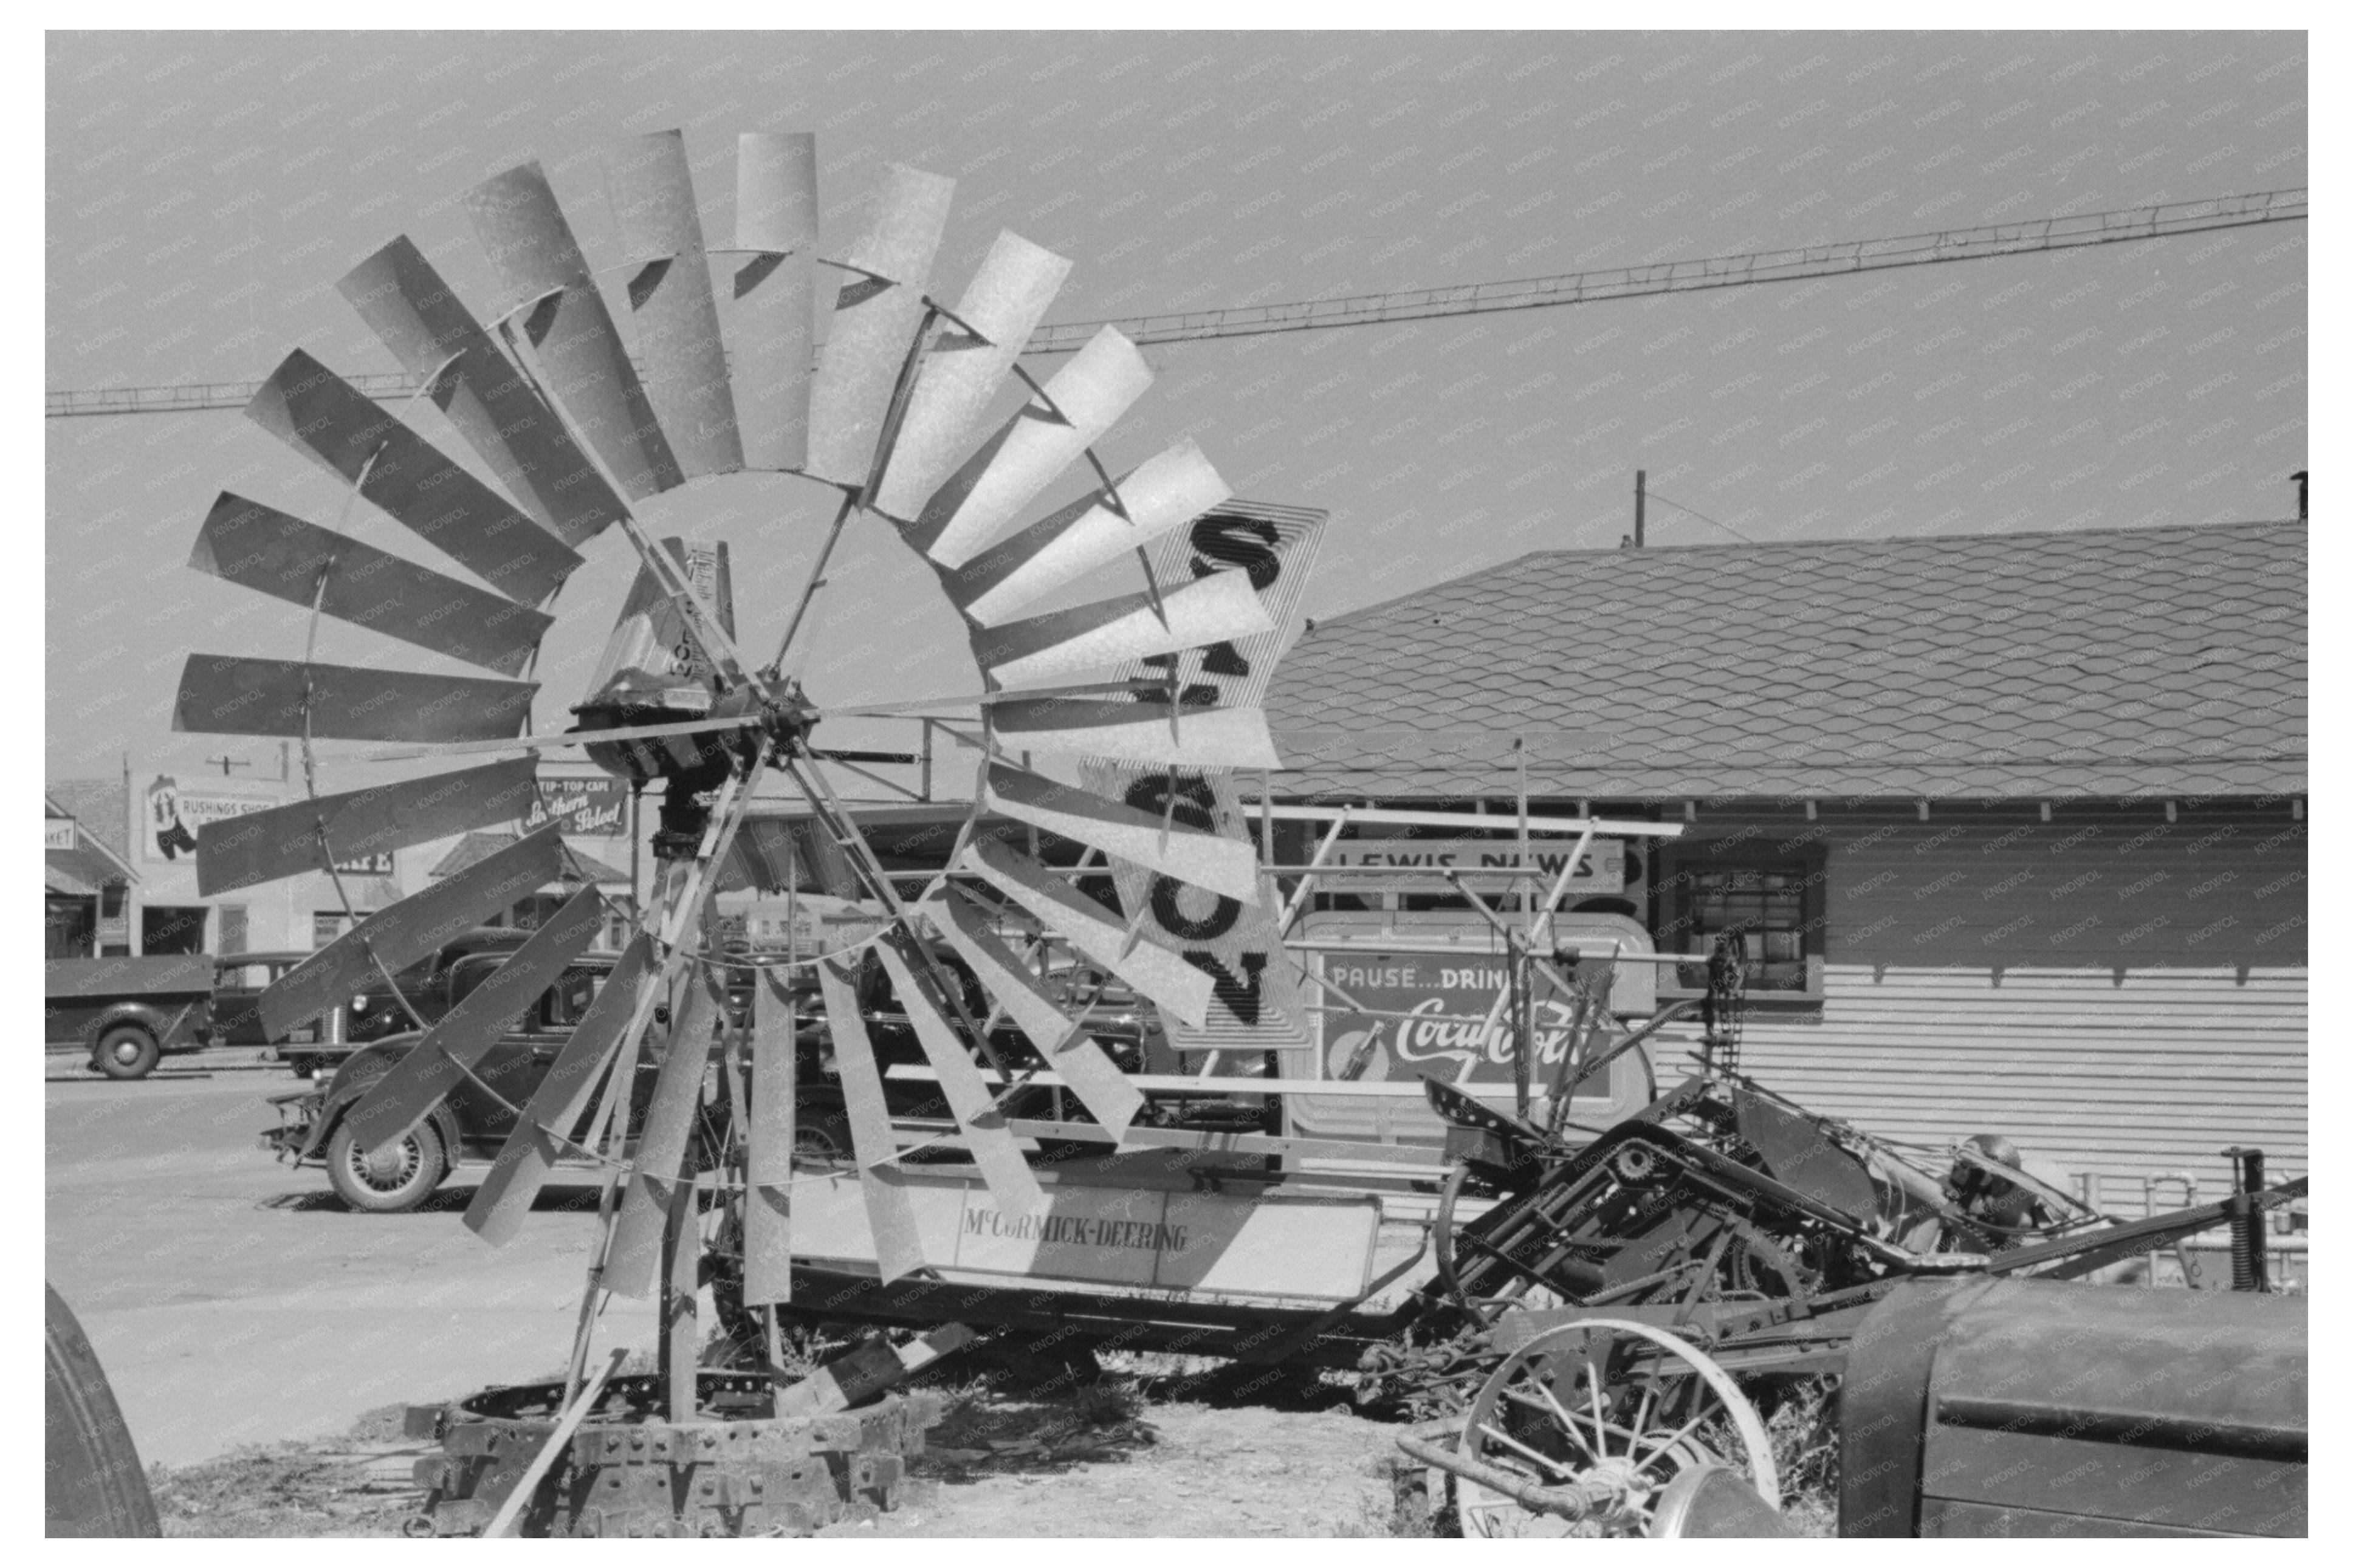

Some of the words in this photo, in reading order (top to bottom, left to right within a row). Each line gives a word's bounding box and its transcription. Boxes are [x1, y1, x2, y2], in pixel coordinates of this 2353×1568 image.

[1126, 515, 1280, 1027] SSON
[184, 801, 236, 815] RUSHINGS
[526, 795, 588, 826] Sothern
[334, 852, 391, 871] FE
[1396, 998, 1593, 1065] CocaCola
